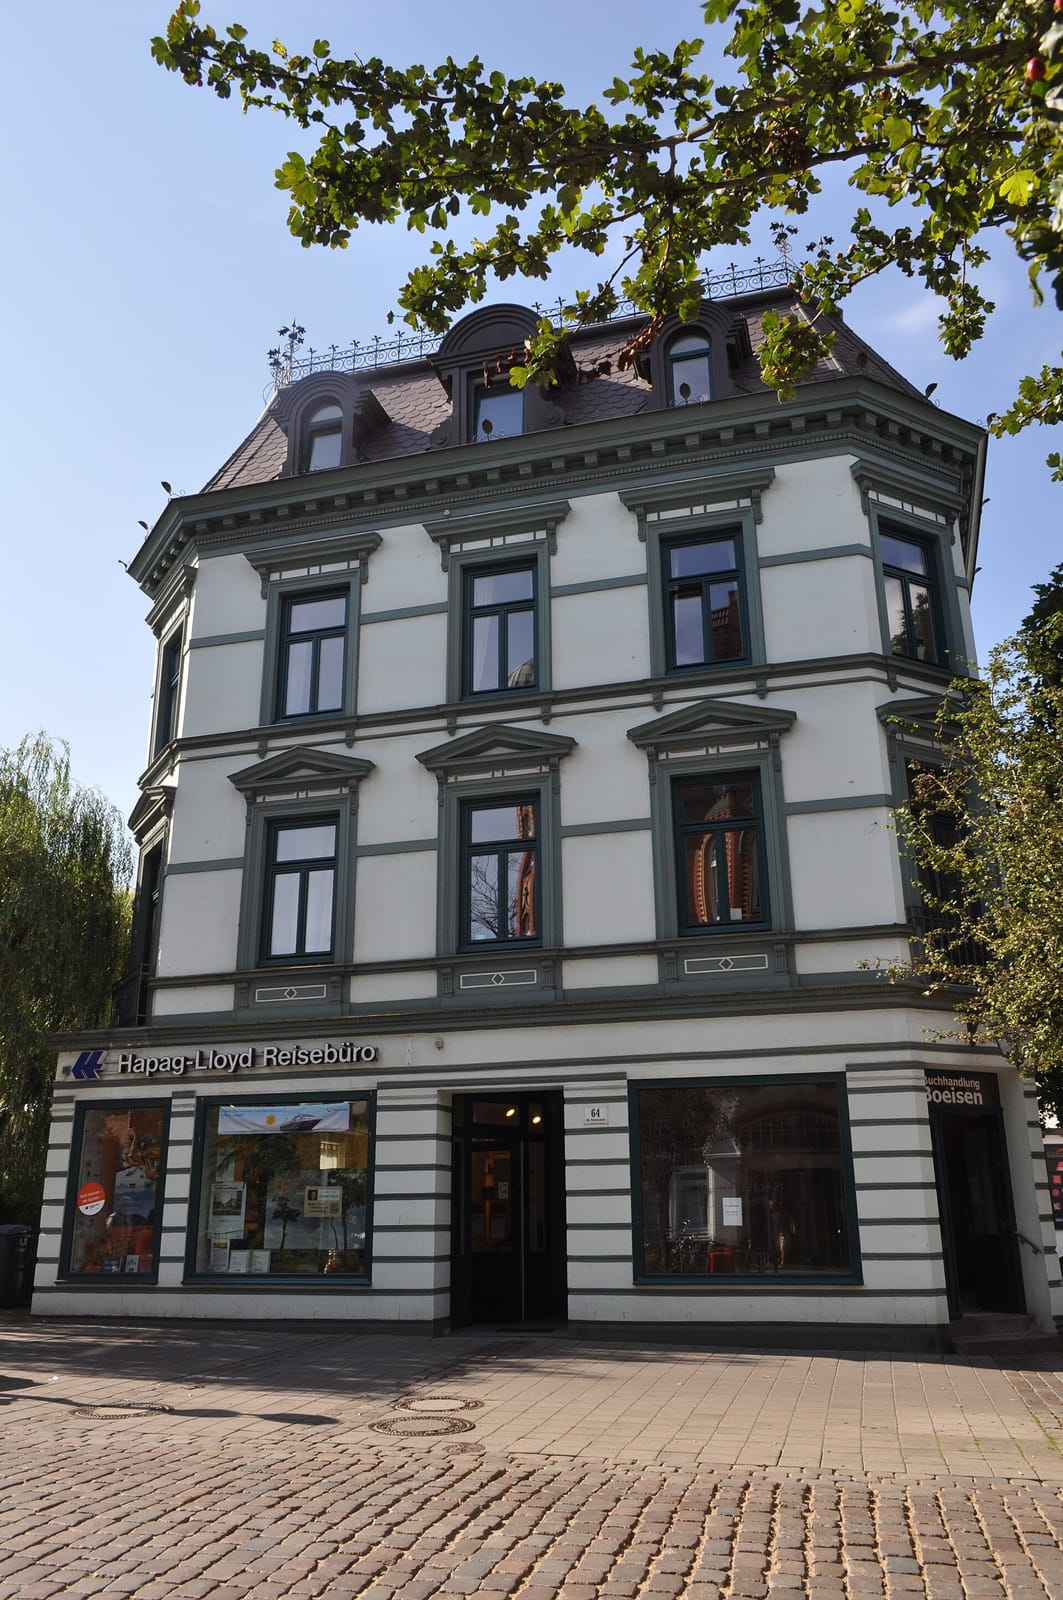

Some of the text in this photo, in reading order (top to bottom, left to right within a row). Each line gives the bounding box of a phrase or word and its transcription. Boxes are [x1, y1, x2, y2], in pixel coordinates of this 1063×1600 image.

[117, 1042, 379, 1077] Hapag-Lloyd Reisebüro
[591, 1108, 600, 1118] 64
